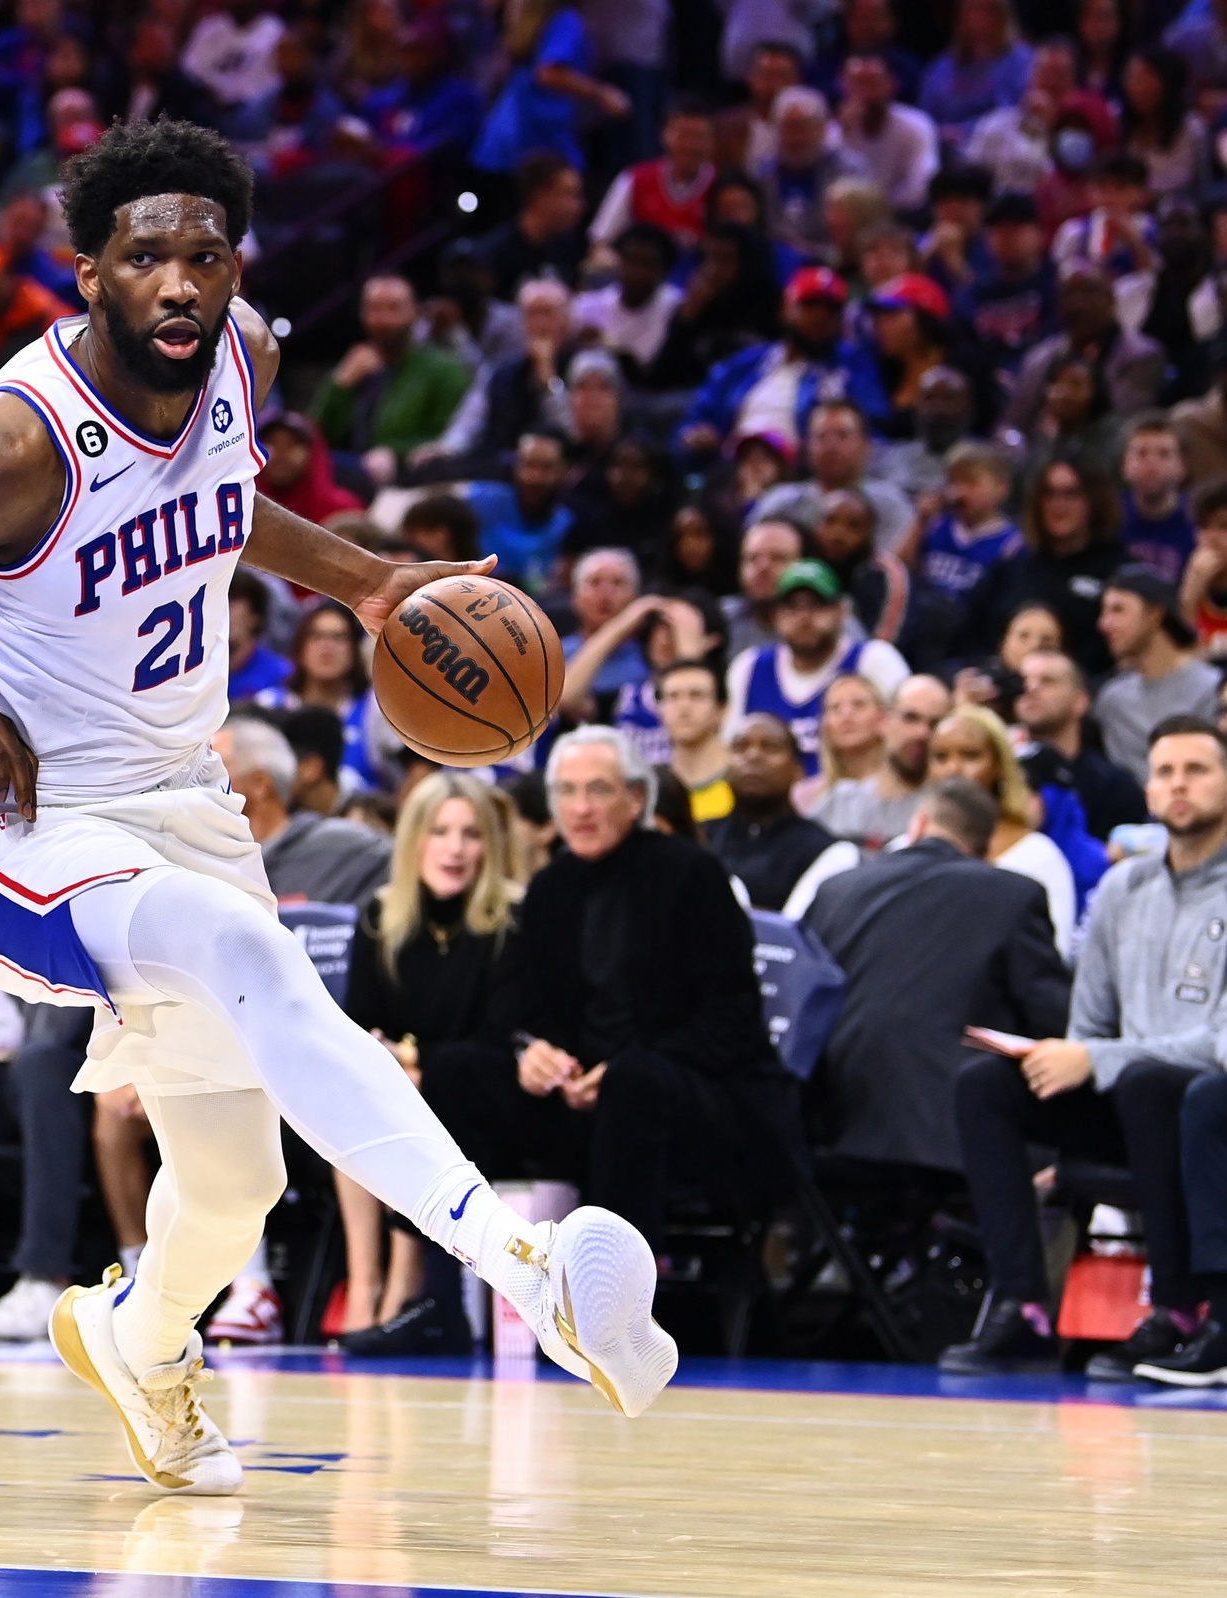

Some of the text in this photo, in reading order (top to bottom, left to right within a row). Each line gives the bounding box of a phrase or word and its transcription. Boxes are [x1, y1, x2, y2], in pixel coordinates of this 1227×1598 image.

[81, 425, 104, 454] 6
[208, 432, 245, 456] crypto.com
[75, 482, 245, 617] PHILA
[132, 583, 207, 692] 21
[399, 604, 490, 705] Wilson
